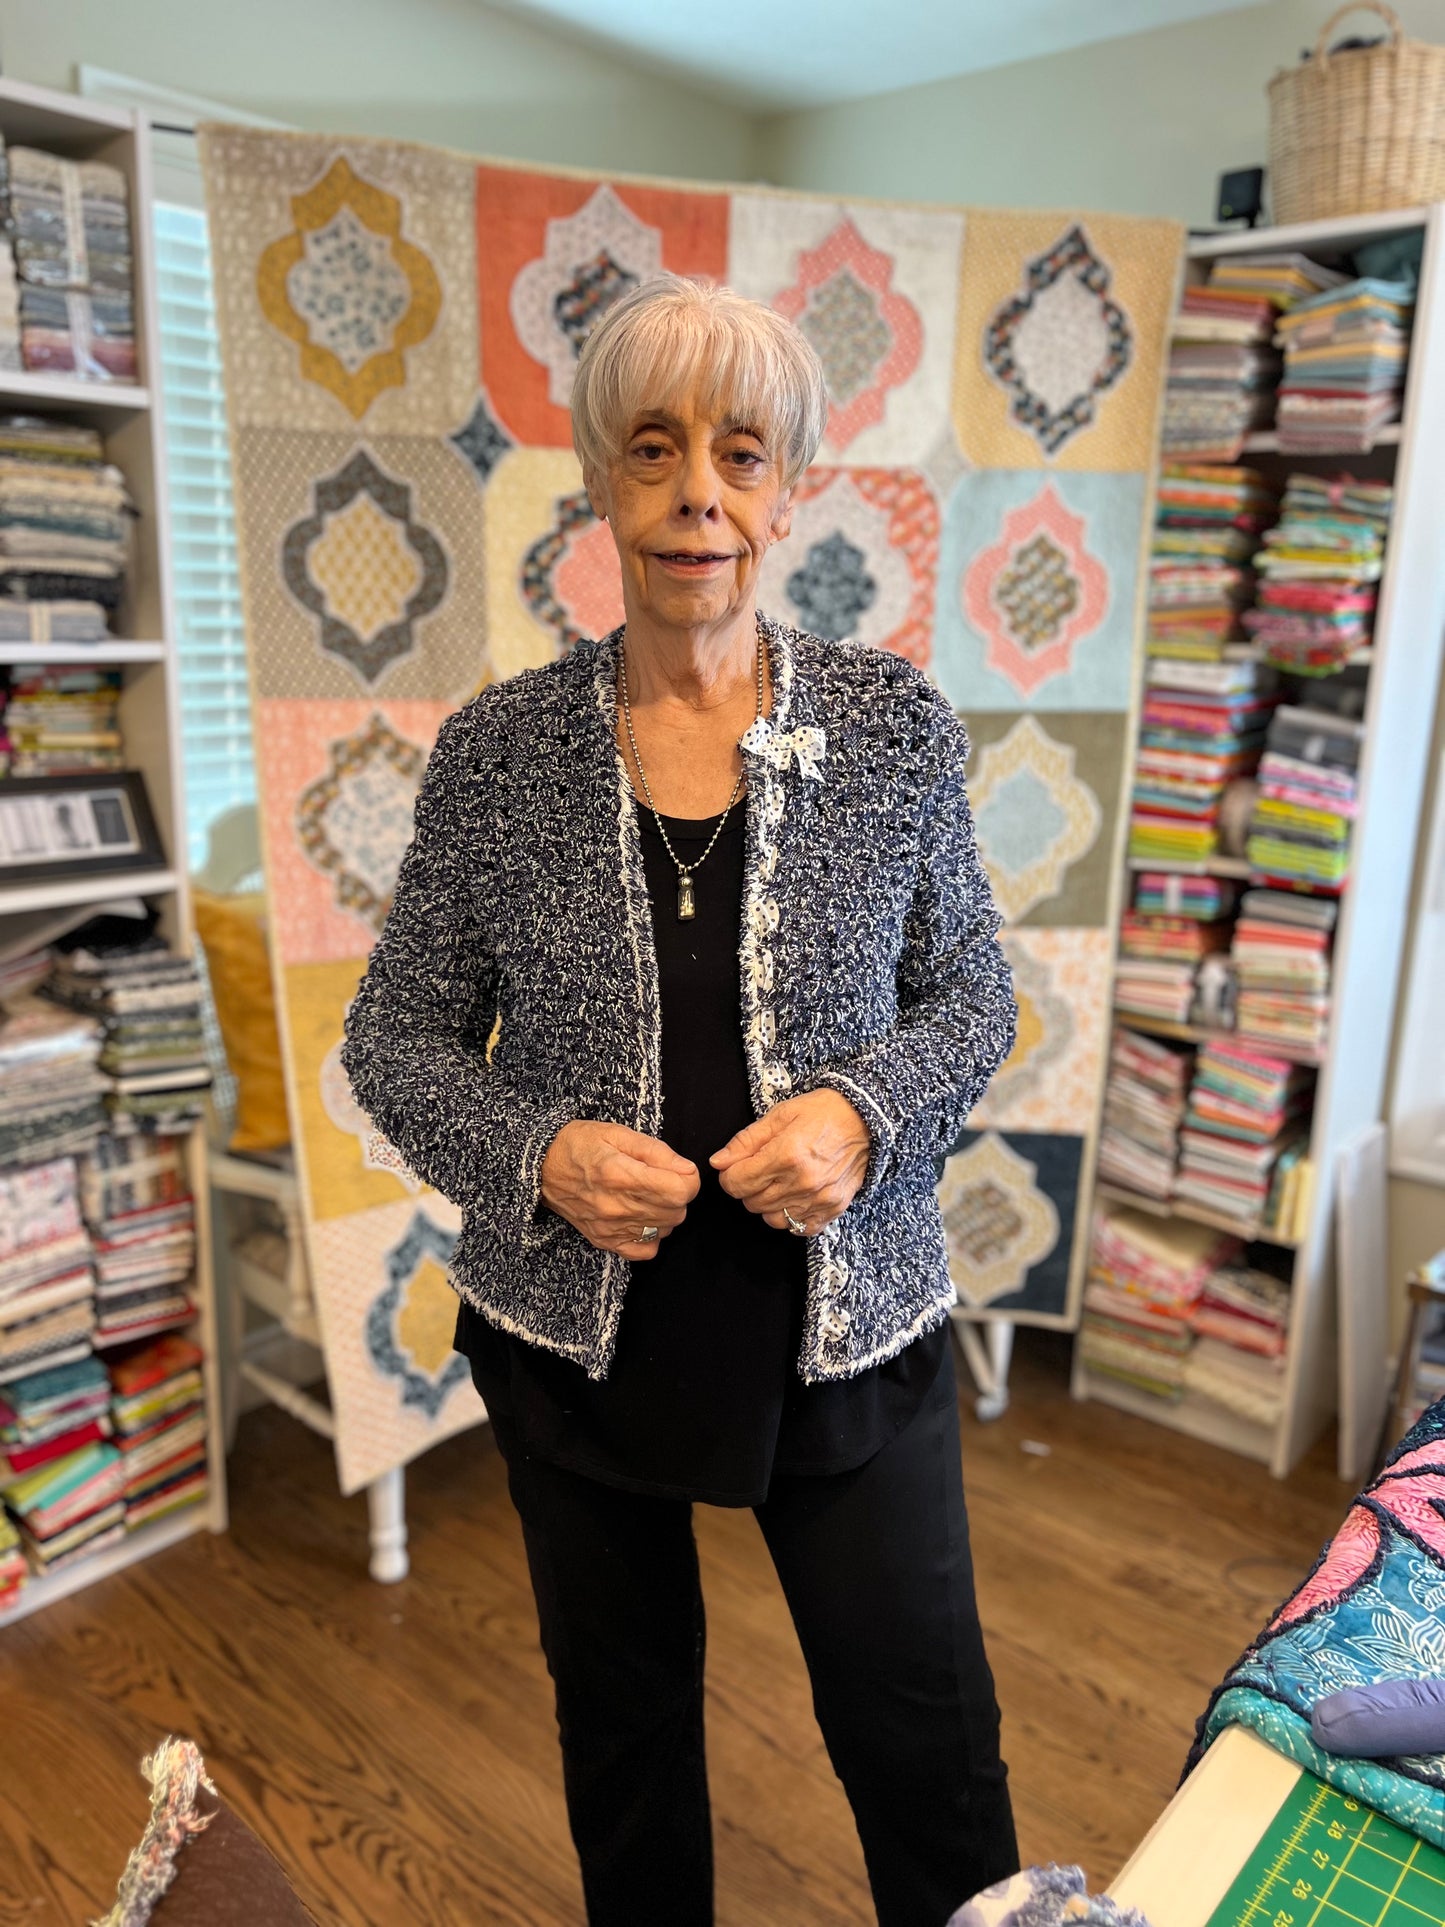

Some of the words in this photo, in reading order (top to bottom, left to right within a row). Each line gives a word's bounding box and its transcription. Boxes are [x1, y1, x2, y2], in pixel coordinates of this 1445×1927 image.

[1327, 1820, 1347, 1840] 28
[1312, 1849, 1330, 1870] 27
[1292, 1878, 1312, 1900] 26
